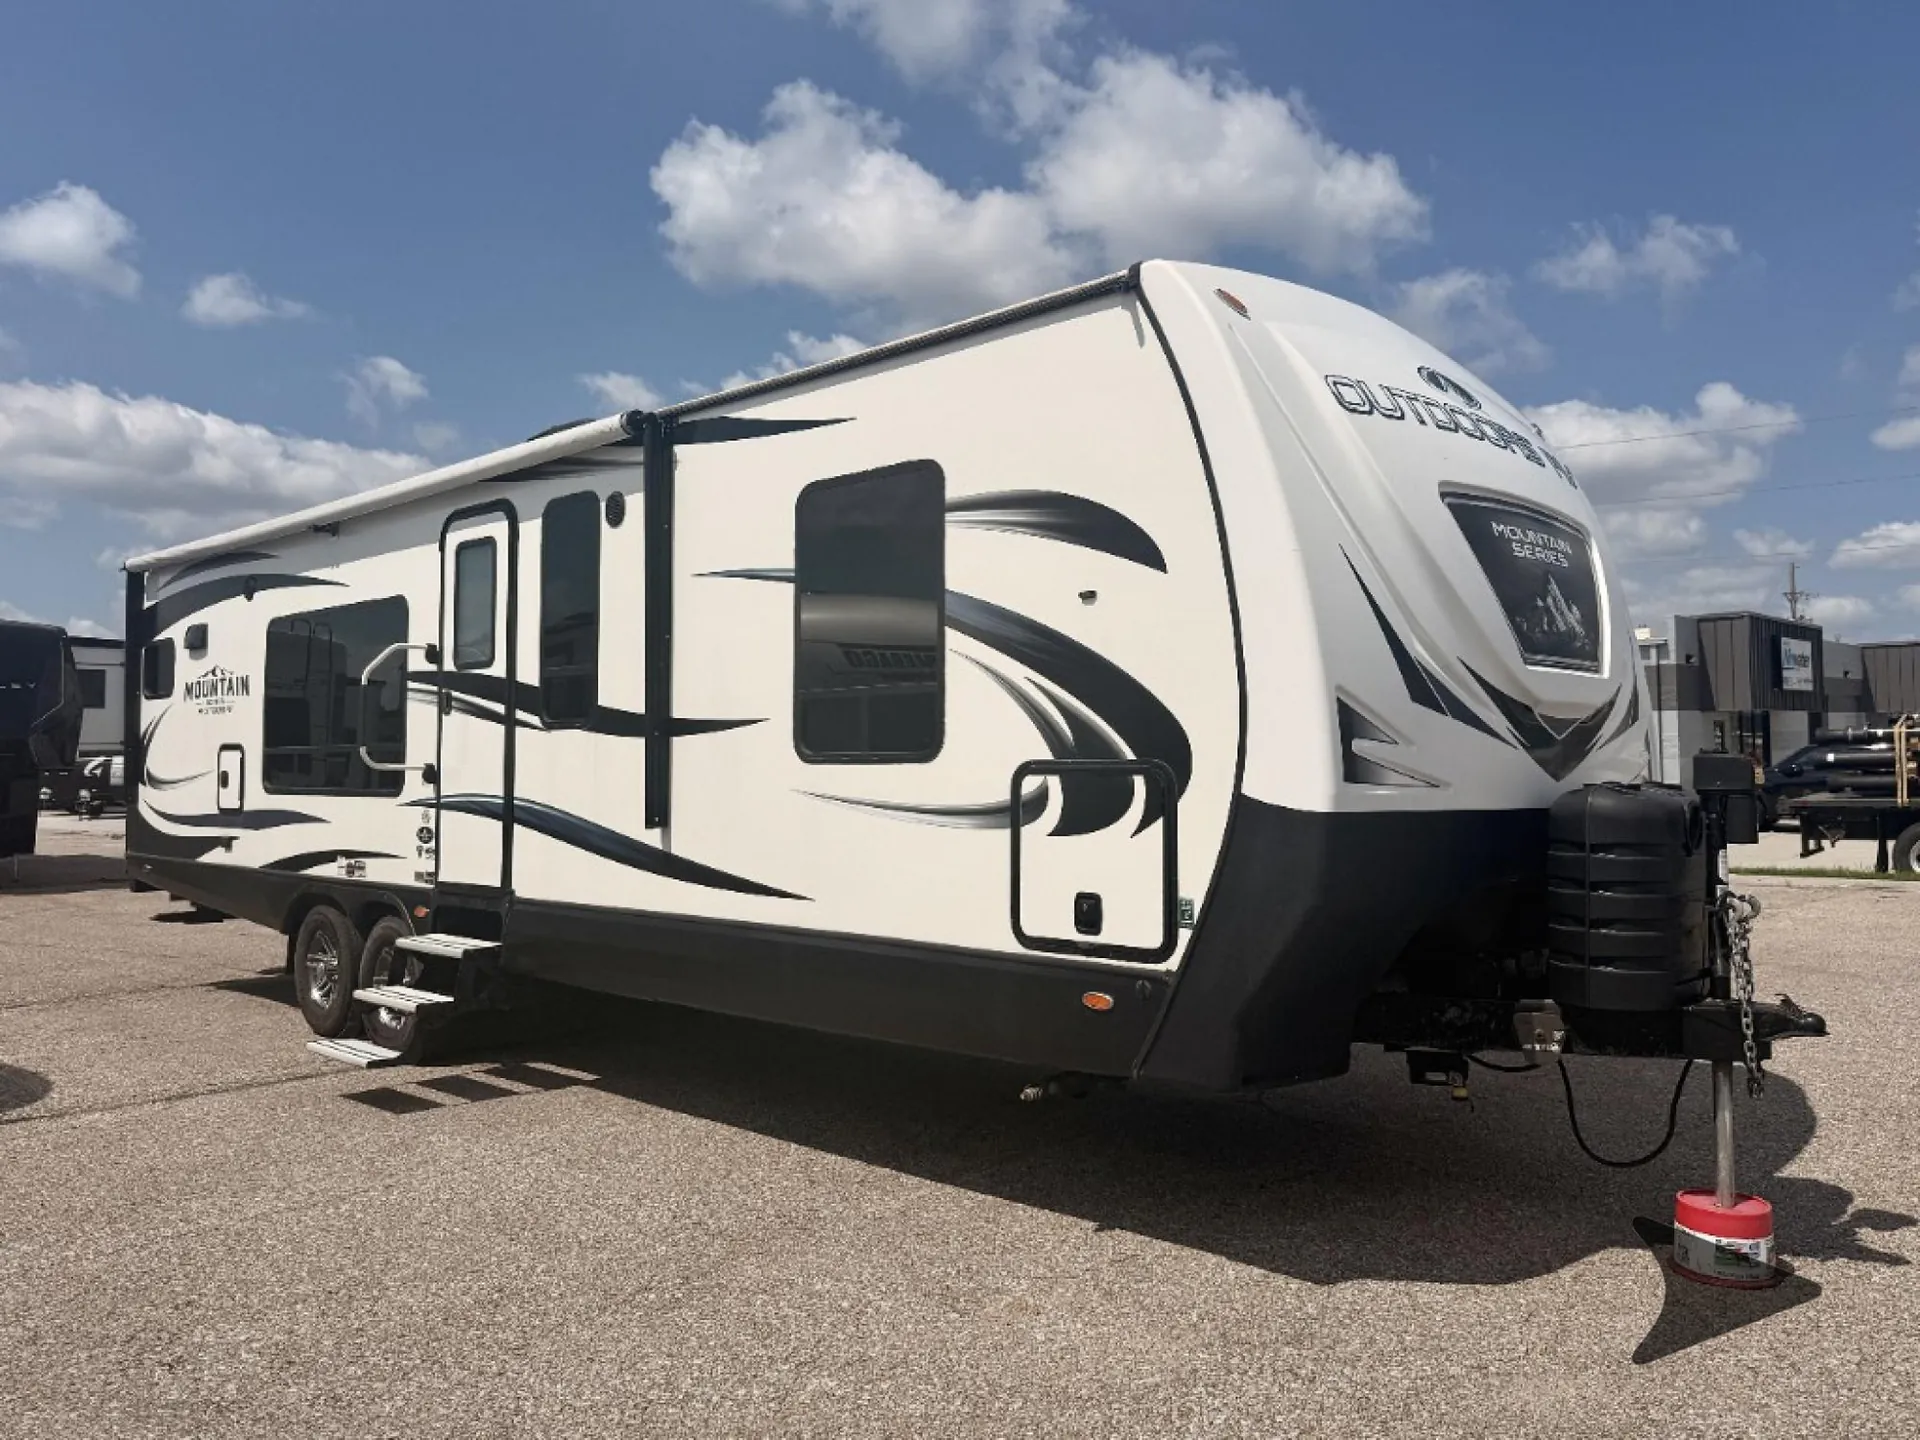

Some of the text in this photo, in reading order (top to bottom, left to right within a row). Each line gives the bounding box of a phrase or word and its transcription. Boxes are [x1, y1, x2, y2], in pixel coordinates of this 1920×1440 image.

[1490, 521, 1572, 554] MOUNTAIN
[1512, 541, 1569, 568] SERIES
[184, 675, 250, 702] MOUNTAIN
